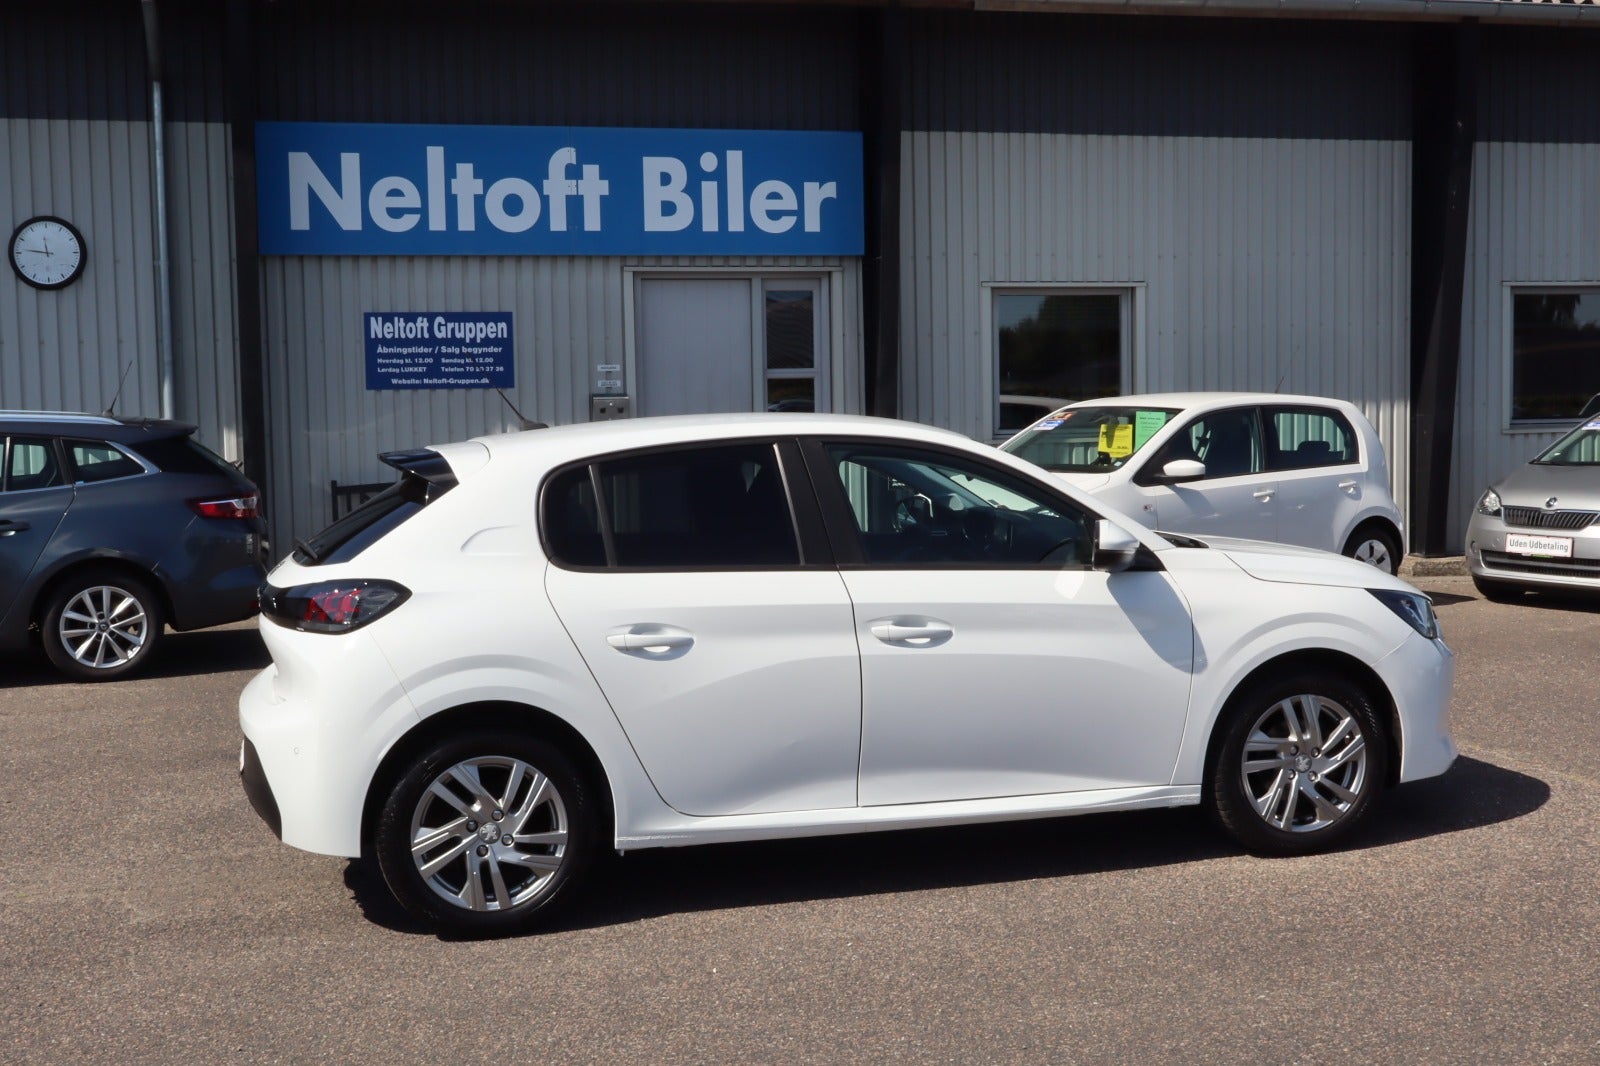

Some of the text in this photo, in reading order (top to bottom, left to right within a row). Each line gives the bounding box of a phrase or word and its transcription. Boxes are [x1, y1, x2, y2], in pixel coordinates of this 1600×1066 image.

[288, 146, 838, 234] Neltoft Biler
[370, 316, 507, 343] Neltoft Gruppen
[377, 344, 502, 354] Åbningstider / Salg begynder
[1509, 538, 1569, 552] Uden Udbetaling
